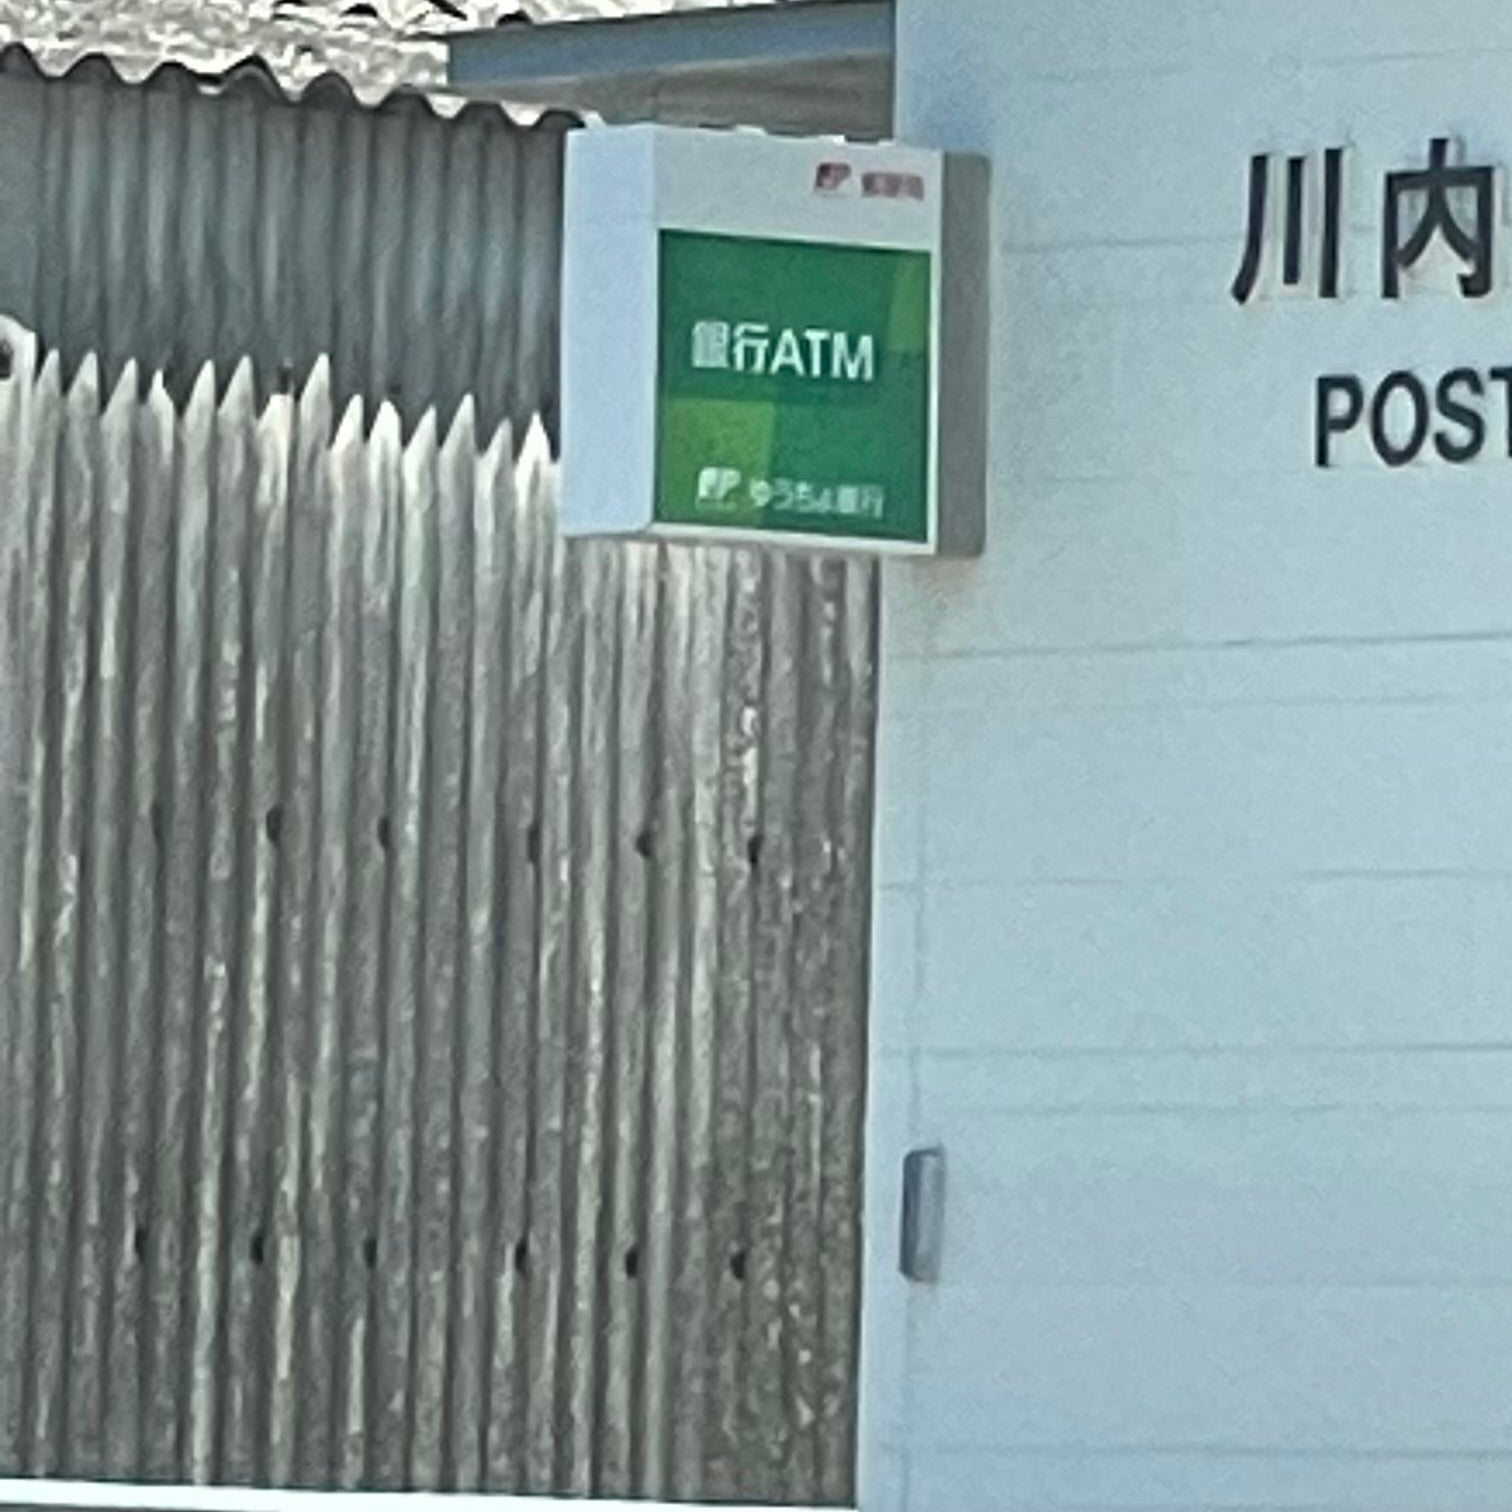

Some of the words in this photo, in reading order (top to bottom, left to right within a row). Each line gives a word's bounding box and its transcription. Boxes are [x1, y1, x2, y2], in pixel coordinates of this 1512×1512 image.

[750, 477, 884, 519] ゆうちょ行
